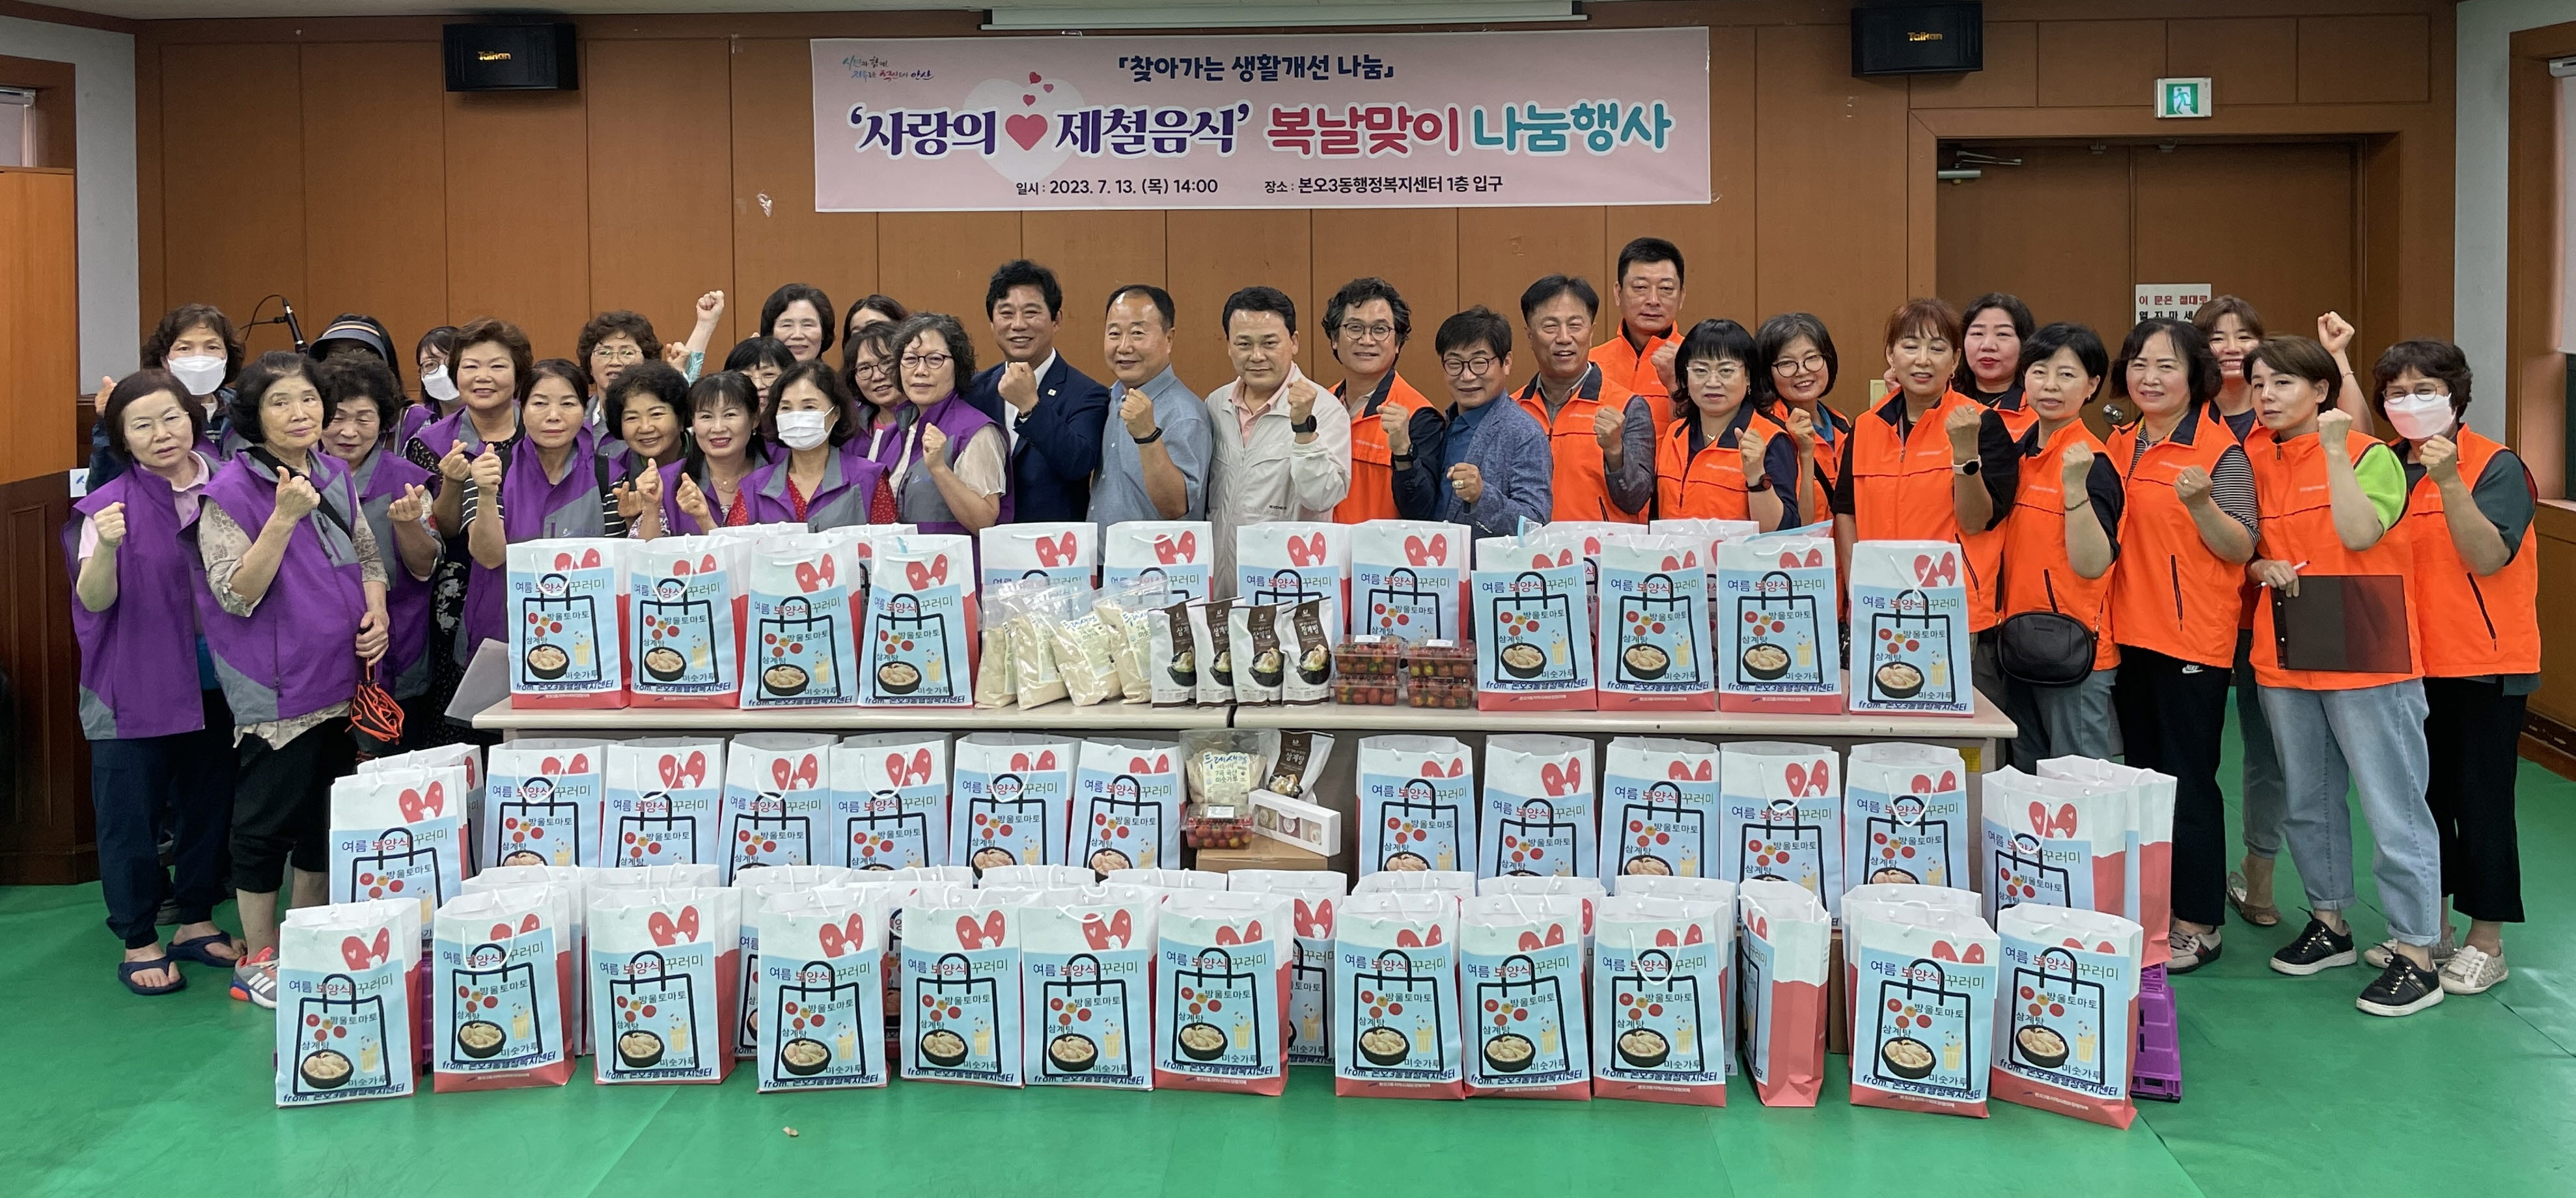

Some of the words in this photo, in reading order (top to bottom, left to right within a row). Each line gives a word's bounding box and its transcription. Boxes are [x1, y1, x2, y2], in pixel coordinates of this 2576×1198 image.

[1232, 55, 1329, 83] 생활개선
[1268, 104, 1458, 155] 복날맞이
[1474, 102, 1672, 152] 나눔행사
[1050, 180, 1094, 194] 2023.
[1098, 180, 1111, 194] 7.
[1116, 180, 1136, 194] 13.
[1141, 178, 1169, 195] (목)
[1174, 180, 1218, 194] 14:00
[1298, 176, 1443, 194] 본오3동행정복지센터
[1447, 176, 1469, 193] 1층
[1473, 175, 1503, 193] 입구
[2139, 296, 2148, 305] 이
[2155, 296, 2172, 305] 문은
[1361, 574, 1380, 585] 여름
[1419, 577, 1450, 589] 꾸러미
[1482, 579, 1504, 593] 여름
[1547, 577, 1577, 592] 꾸러미
[1728, 579, 1751, 591] 여름
[1793, 578, 1825, 591] 꾸러미
[755, 602, 769, 615] 여름
[812, 596, 840, 613] 꾸러미
[1863, 595, 1886, 608] 여름
[1929, 597, 1960, 610] 꾸러미
[1085, 779, 1103, 792] 여름
[1141, 784, 1172, 798] 꾸러미
[1372, 785, 1394, 798] 여름
[1437, 787, 1467, 800] 꾸러미
[1614, 787, 1638, 800] 여름
[1682, 792, 1713, 805] 꾸러미
[838, 801, 860, 813] 여름
[902, 795, 937, 809] 꾸러미
[342, 840, 367, 852] 여름
[414, 828, 448, 843] 꾸러미
[1033, 964, 1056, 977] 여름
[1100, 960, 1138, 975] 꾸러미
[1167, 951, 1187, 966] 여름
[1232, 953, 1267, 969] 꾸러미
[1344, 954, 1367, 969] 여름
[1412, 957, 1446, 972] 꾸러미
[1602, 957, 1626, 971] 여름
[1673, 955, 1706, 971] 꾸러미
[2005, 946, 2029, 965] 여름
[2077, 964, 2118, 981] 꾸러미
[769, 967, 792, 981] 여름
[836, 961, 870, 980] 꾸러미
[1870, 960, 1896, 977] 여름
[1945, 975, 1984, 989] 꾸러미
[288, 980, 312, 994] 여름
[357, 973, 393, 994] 꾸러미
